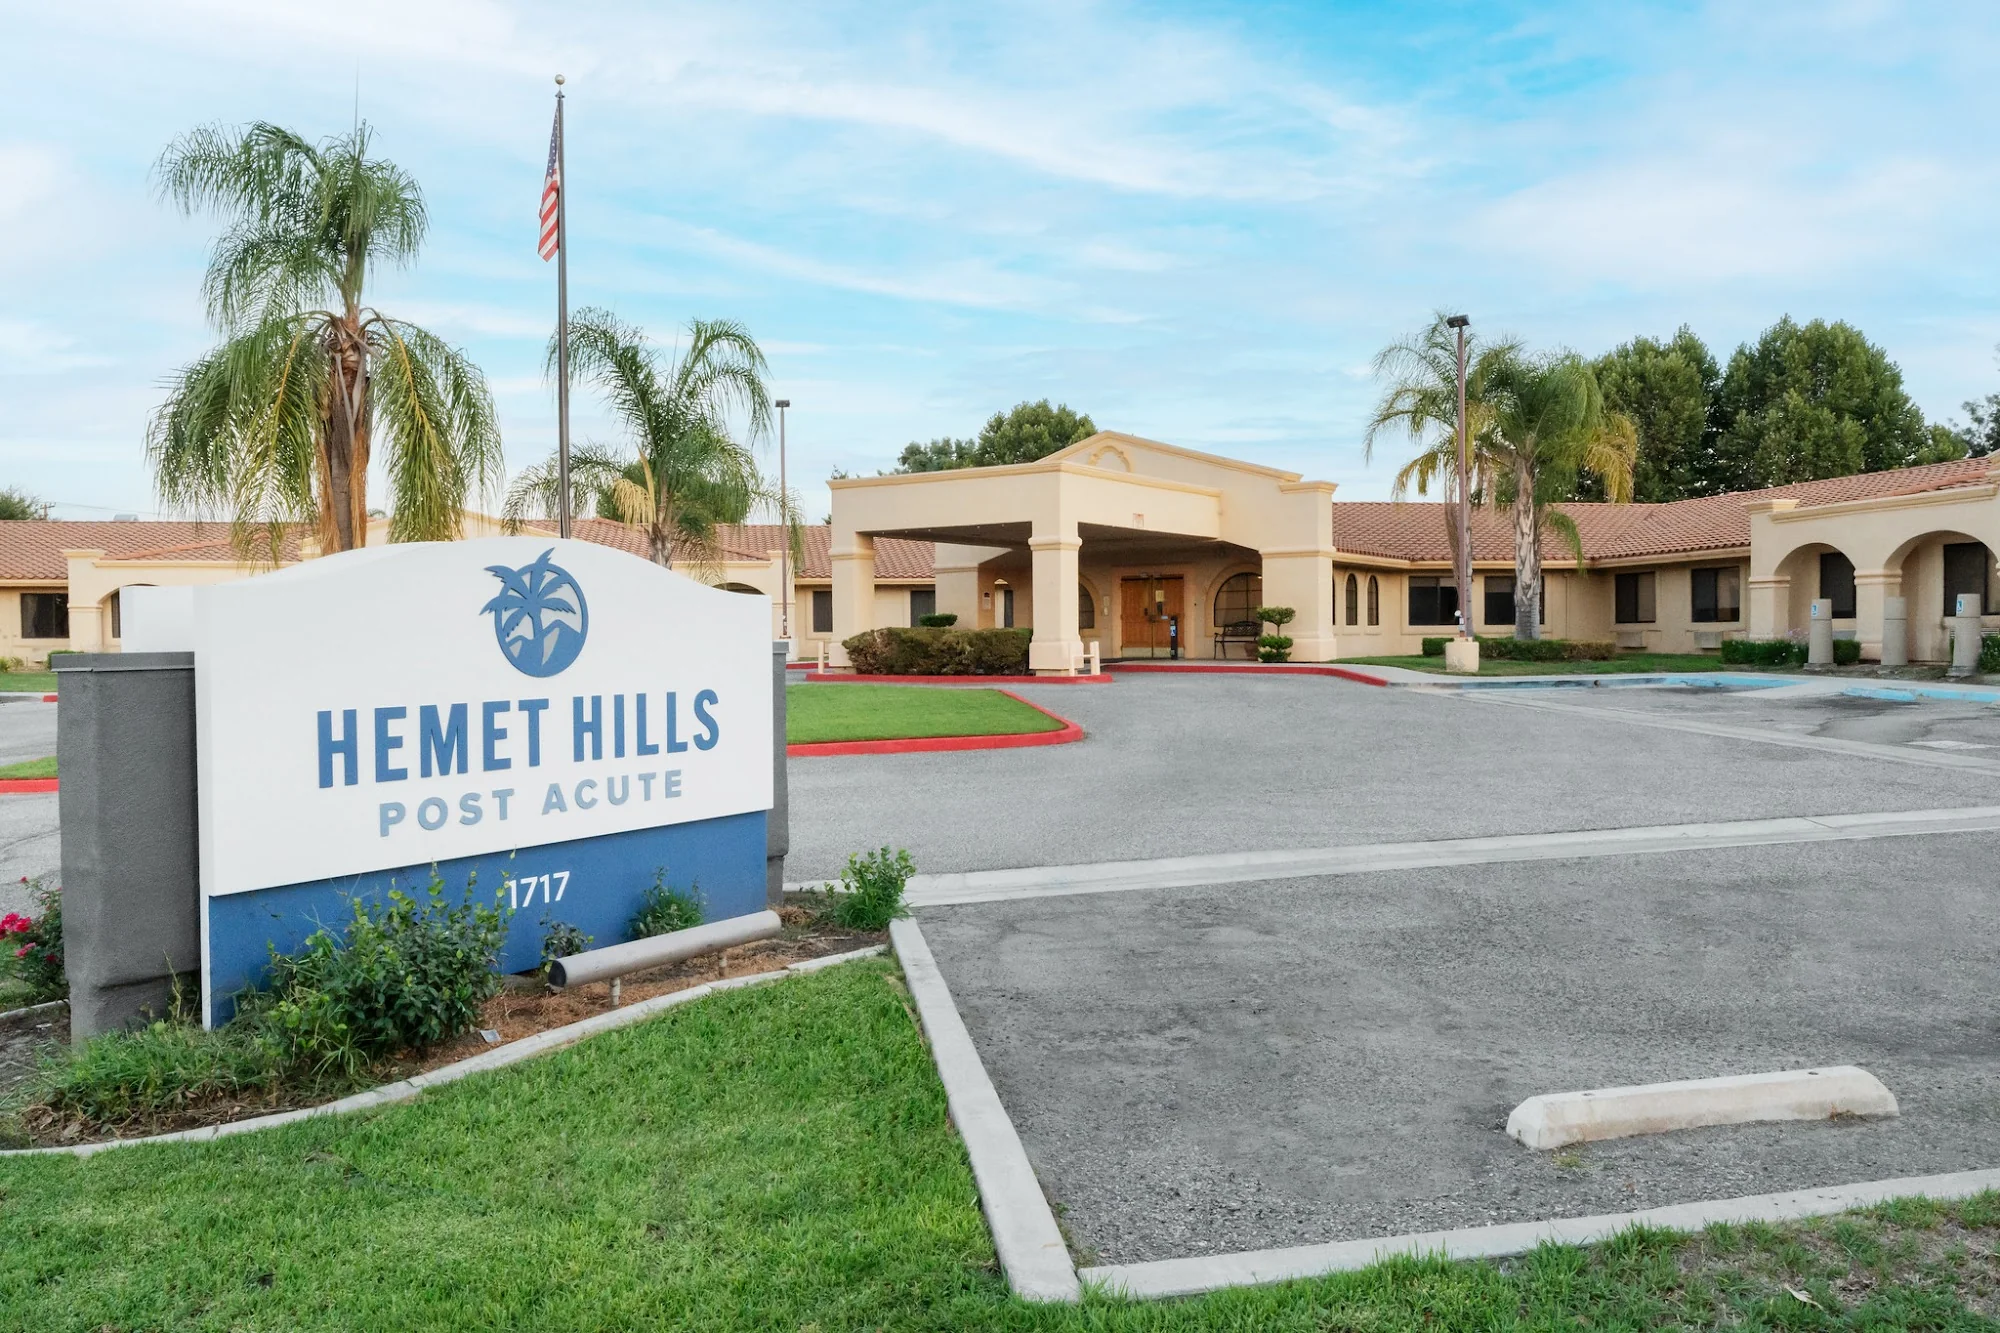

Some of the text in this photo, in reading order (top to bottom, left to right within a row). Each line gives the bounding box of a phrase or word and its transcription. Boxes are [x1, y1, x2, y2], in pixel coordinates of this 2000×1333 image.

[317, 689, 720, 789] HEMET HILLS
[379, 769, 683, 837] POST ACUTE
[508, 871, 570, 909] 1717
